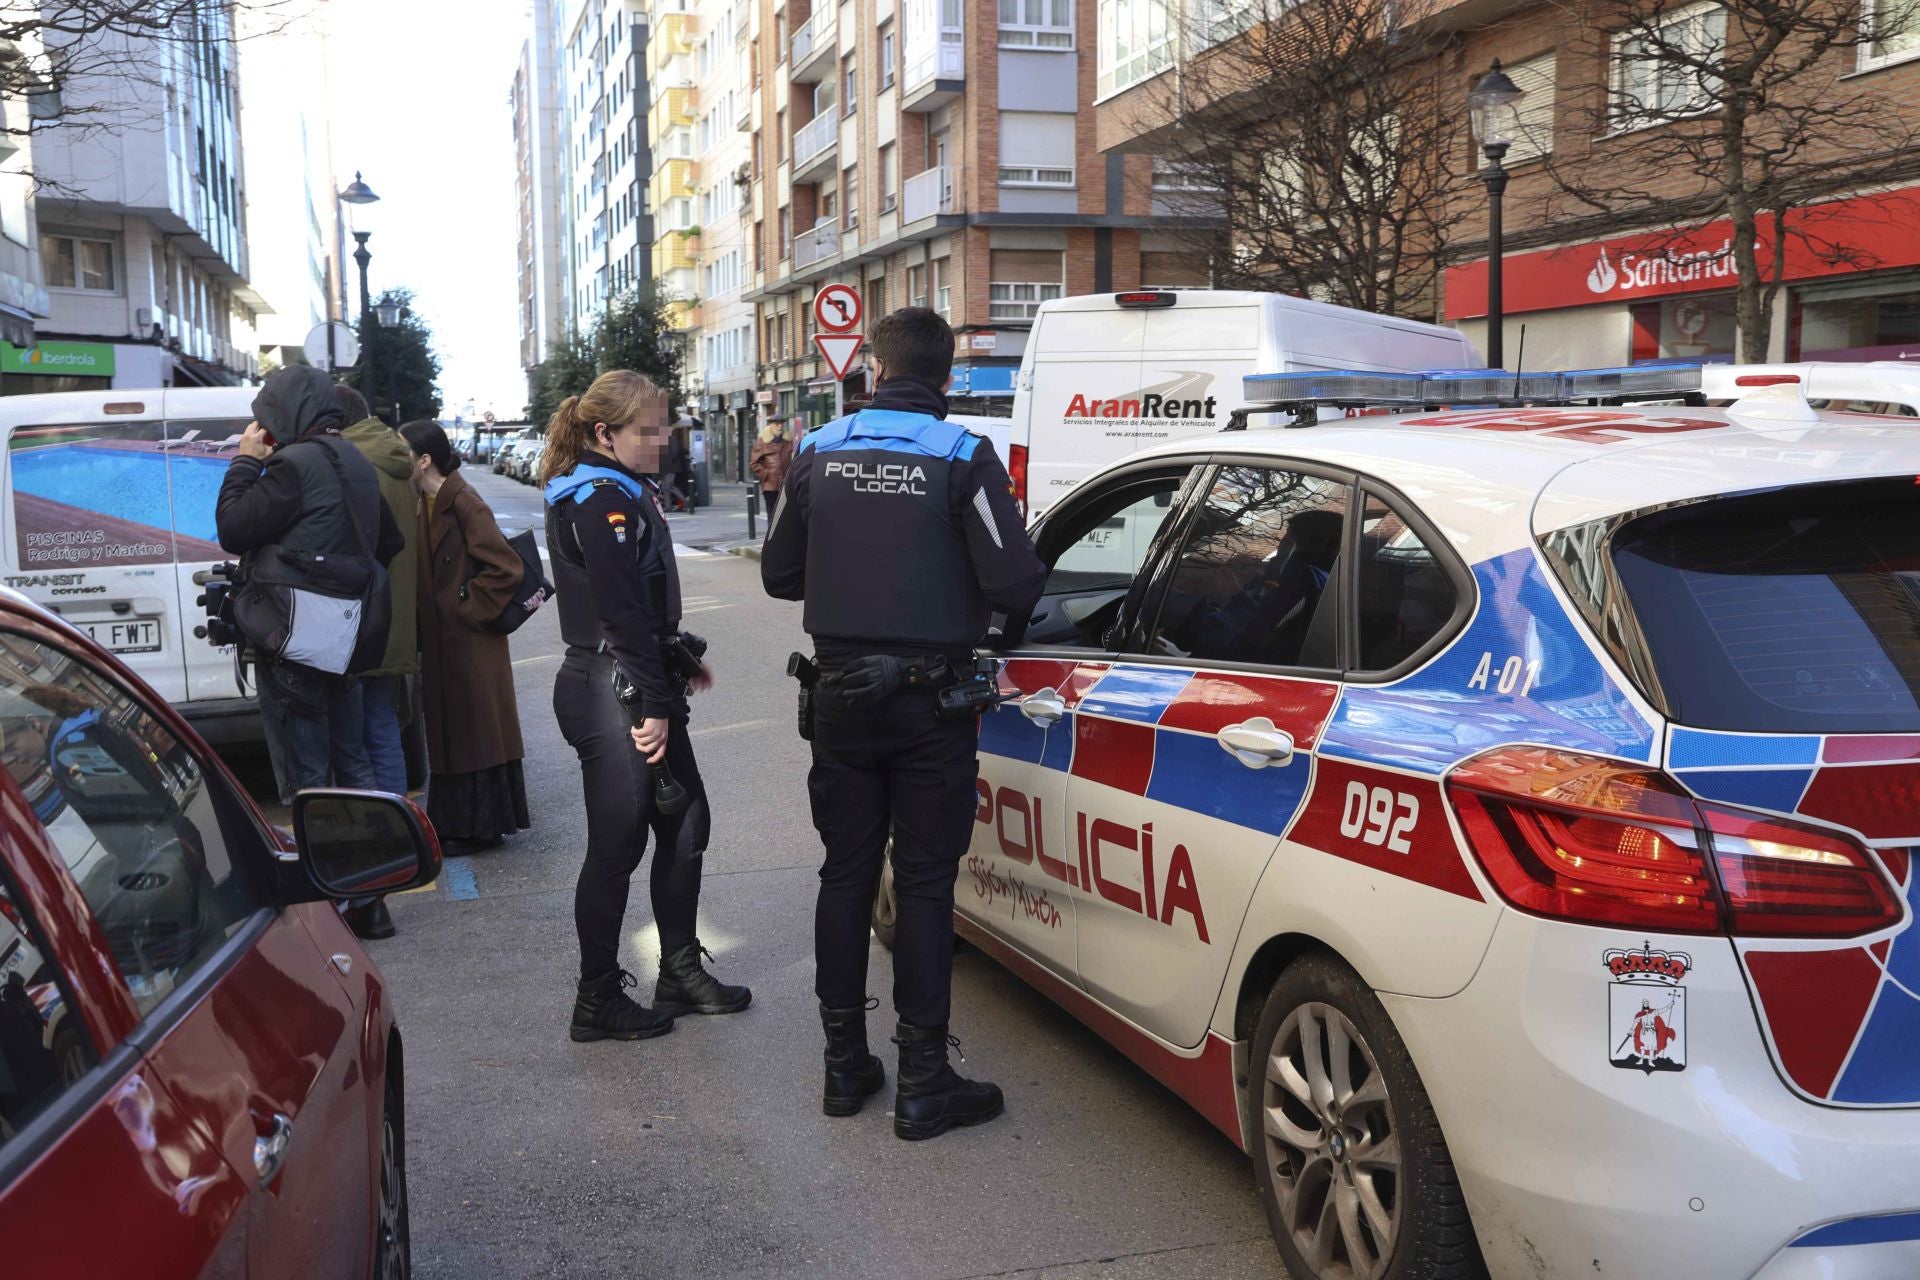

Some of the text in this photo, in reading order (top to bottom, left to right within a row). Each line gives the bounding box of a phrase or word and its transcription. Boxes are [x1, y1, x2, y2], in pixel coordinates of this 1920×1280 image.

[1620, 238, 1760, 290] Santand
[42, 352, 96, 366] Iberdrola
[1064, 393, 1217, 419] AranRent
[1063, 418, 1093, 426] Servicios
[1094, 419, 1129, 427] Integrales
[1140, 419, 1168, 427] Alquiler
[853, 479, 926, 495] LOCAL
[26, 530, 105, 546] PISCINAS
[1087, 531, 1112, 543] MLF
[28, 542, 166, 562] Rodrigo y Martino
[4, 573, 86, 588] TRANSIT
[51, 585, 107, 595] connect
[112, 623, 153, 645] FWT
[1340, 780, 1420, 855] 092
